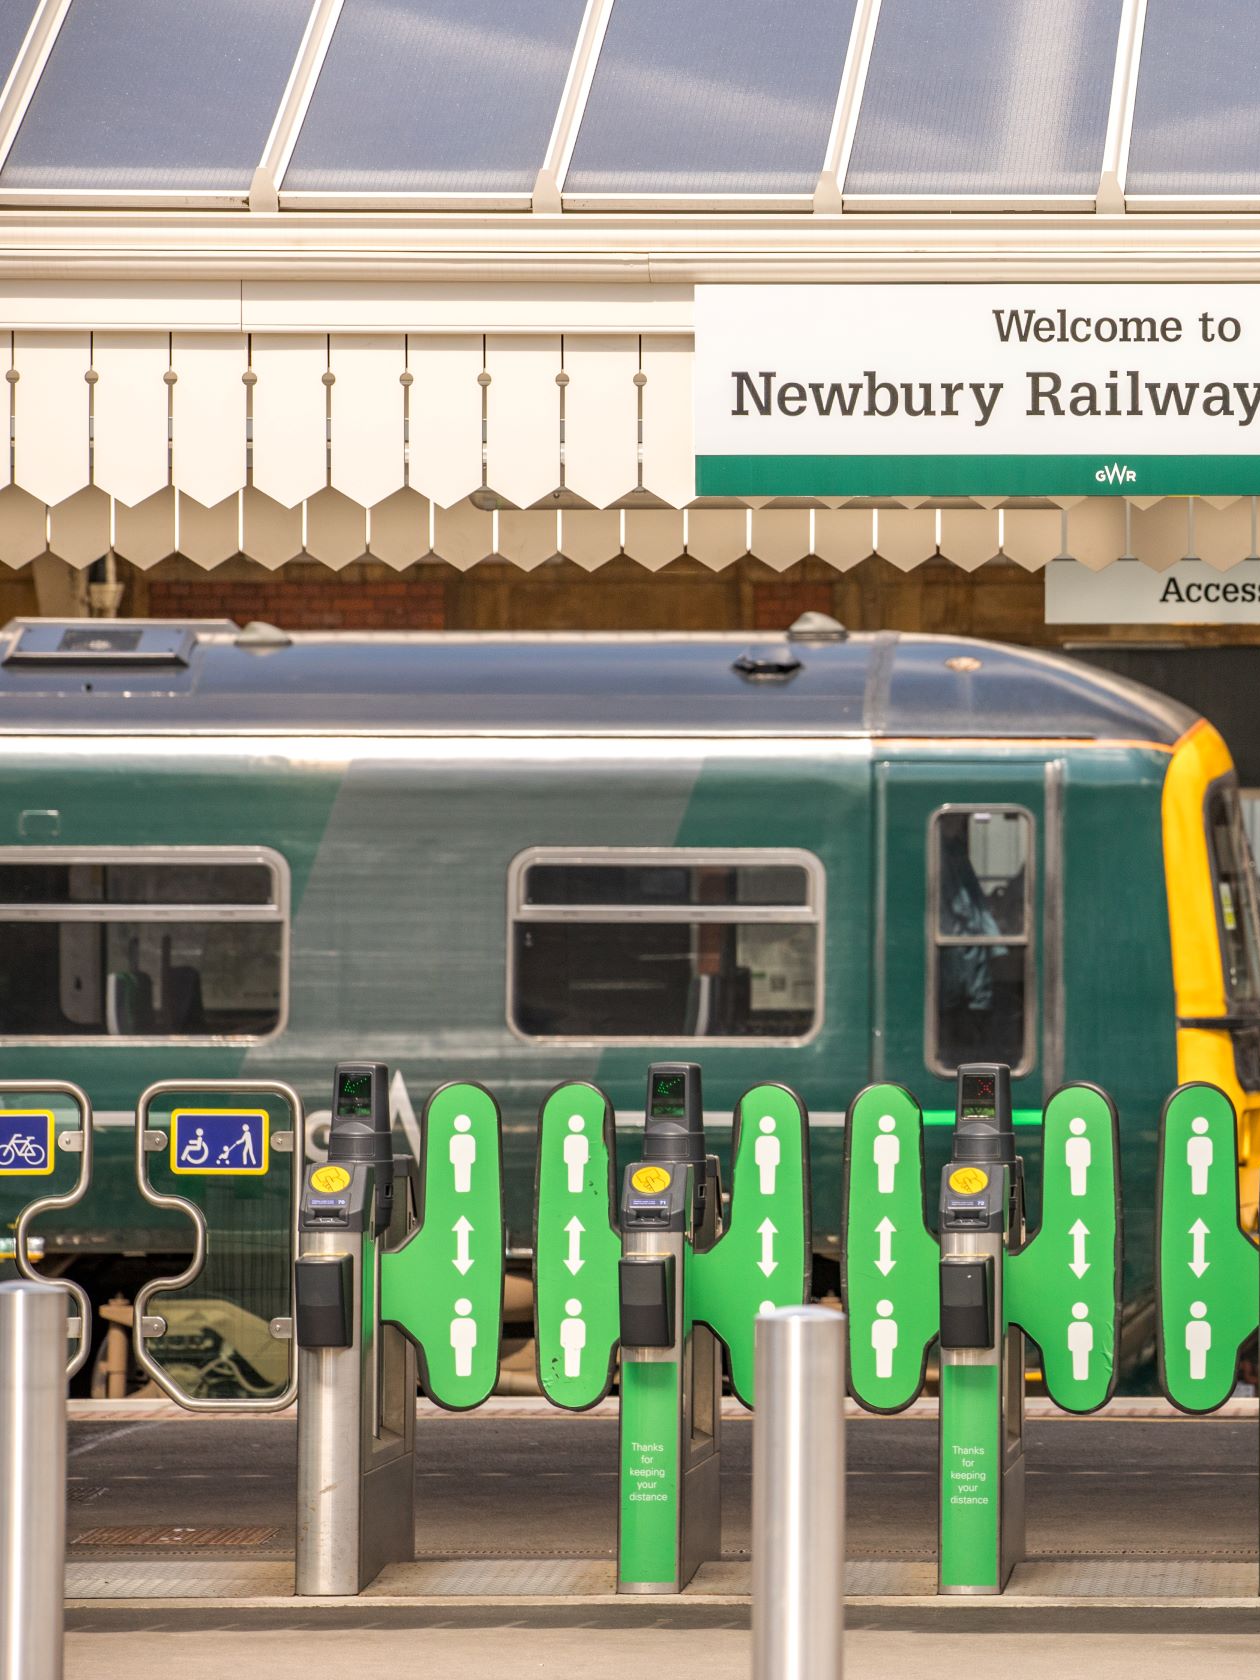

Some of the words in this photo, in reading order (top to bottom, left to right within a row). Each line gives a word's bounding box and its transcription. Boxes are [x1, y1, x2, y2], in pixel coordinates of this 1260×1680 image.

[992, 308, 1183, 343] Welcome
[1198, 312, 1242, 343] to
[731, 370, 1004, 427] Newbury
[1095, 462, 1137, 485] GWR
[632, 1442, 664, 1452] Thanks
[952, 1446, 984, 1455] Thanks
[641, 1455, 653, 1464] for
[962, 1458, 975, 1467] for
[630, 1468, 665, 1478] keeping
[951, 1471, 986, 1481] keeping
[637, 1481, 656, 1490] your
[958, 1485, 978, 1493] your
[629, 1492, 668, 1501] distance
[951, 1496, 988, 1504] distance
